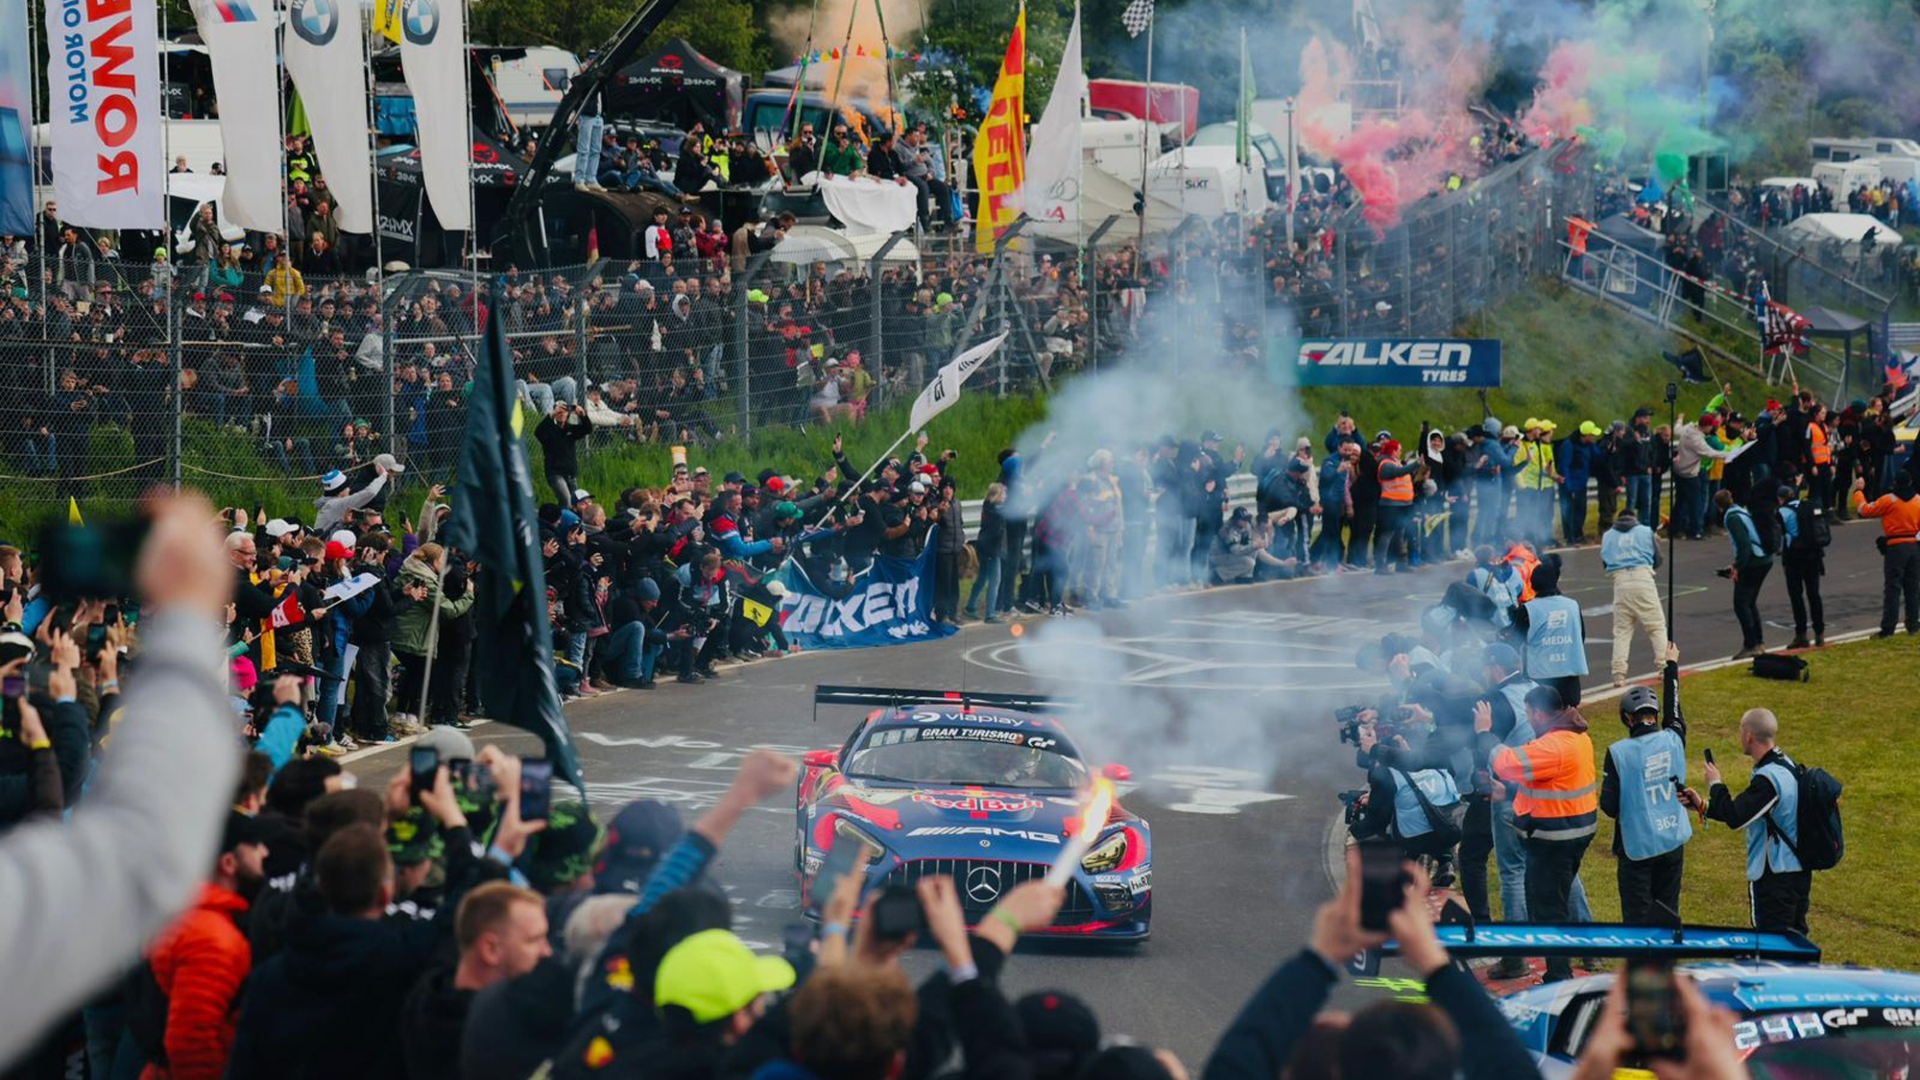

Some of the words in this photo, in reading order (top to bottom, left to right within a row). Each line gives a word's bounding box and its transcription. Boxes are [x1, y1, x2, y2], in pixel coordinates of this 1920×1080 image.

[1297, 342, 1472, 366] FALKEN
[1422, 370, 1467, 382] TYRES
[1541, 635, 1573, 646] MEDIA
[945, 712, 1025, 727] viaplay
[922, 728, 959, 737] GRAN
[961, 728, 1018, 741] TURISMO
[1646, 782, 1675, 805] TV
[1656, 814, 1678, 831] 362
[940, 827, 1061, 844] AMG
